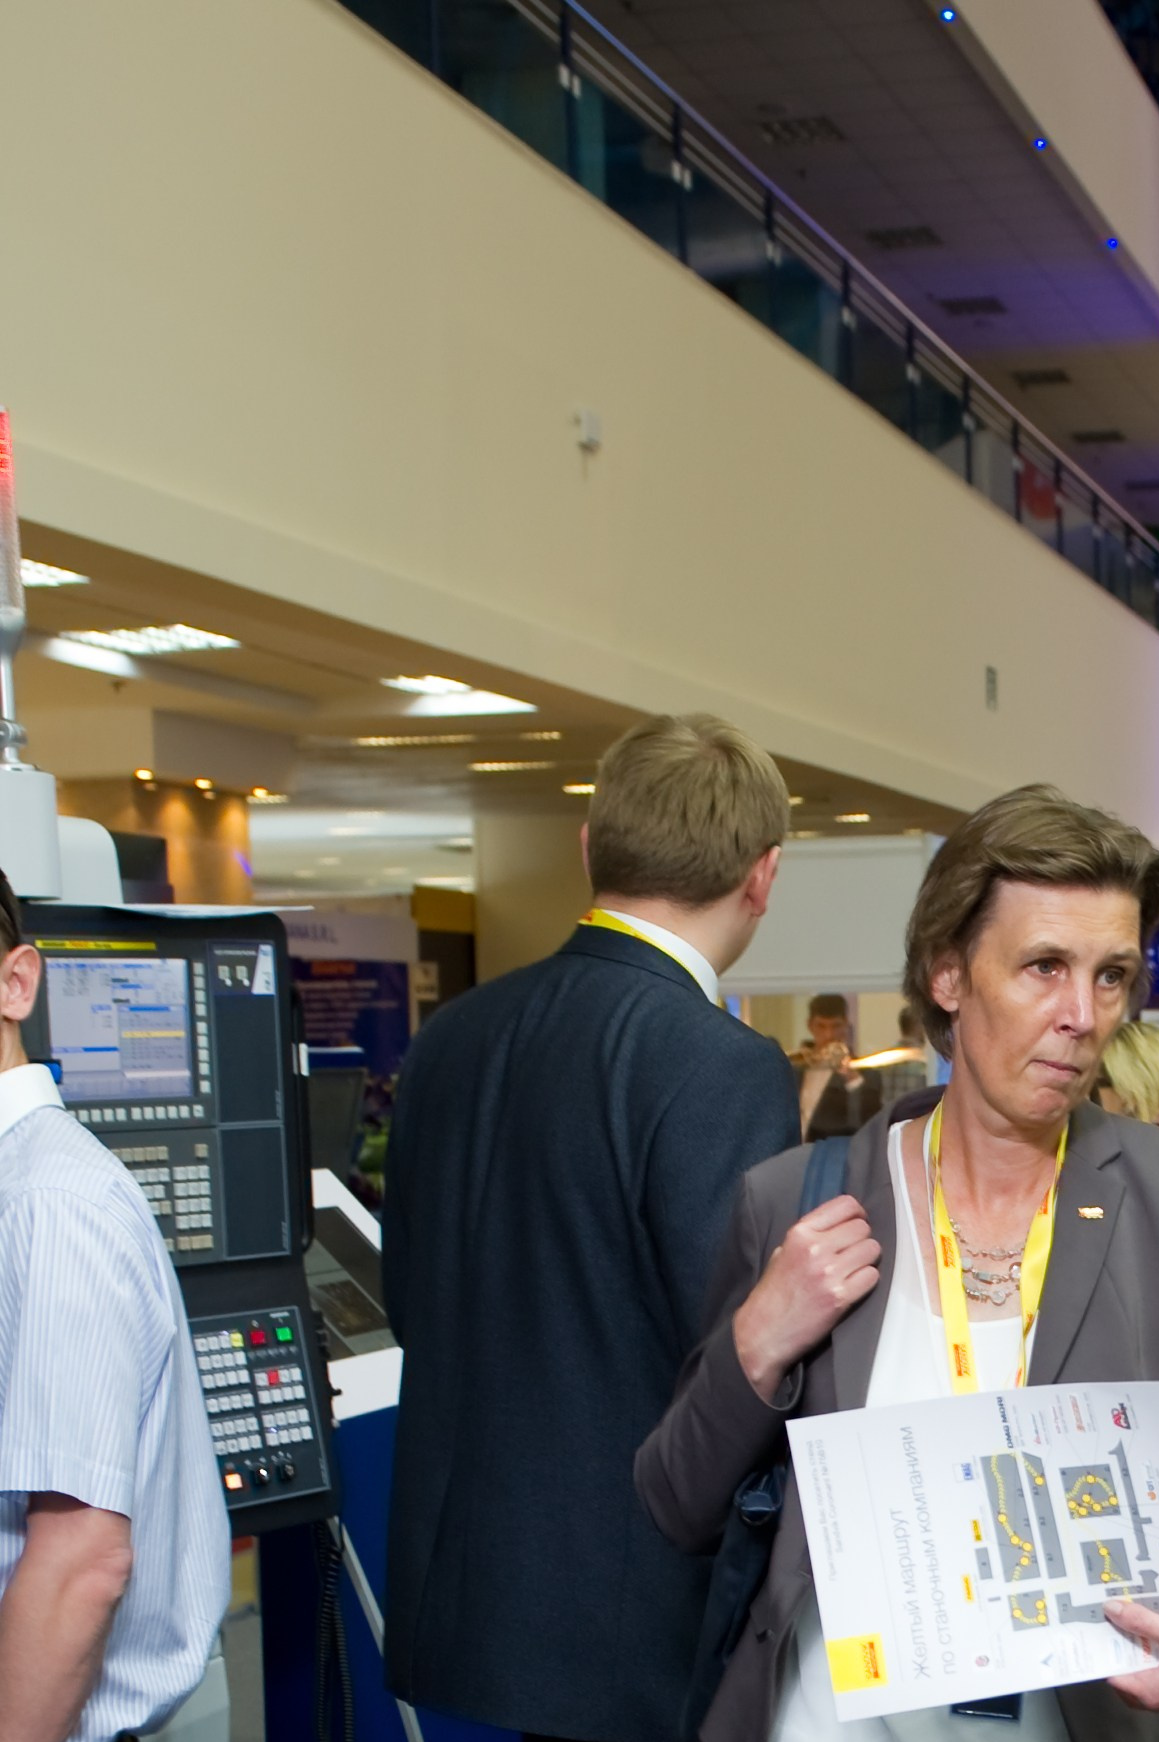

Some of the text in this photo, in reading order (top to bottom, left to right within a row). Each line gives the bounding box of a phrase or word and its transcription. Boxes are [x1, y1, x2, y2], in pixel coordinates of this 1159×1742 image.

[996, 1396, 1009, 1423] MORI
[889, 1508, 931, 1680] Желтый маршрут
[900, 1425, 958, 1676] по станочным компаниям
